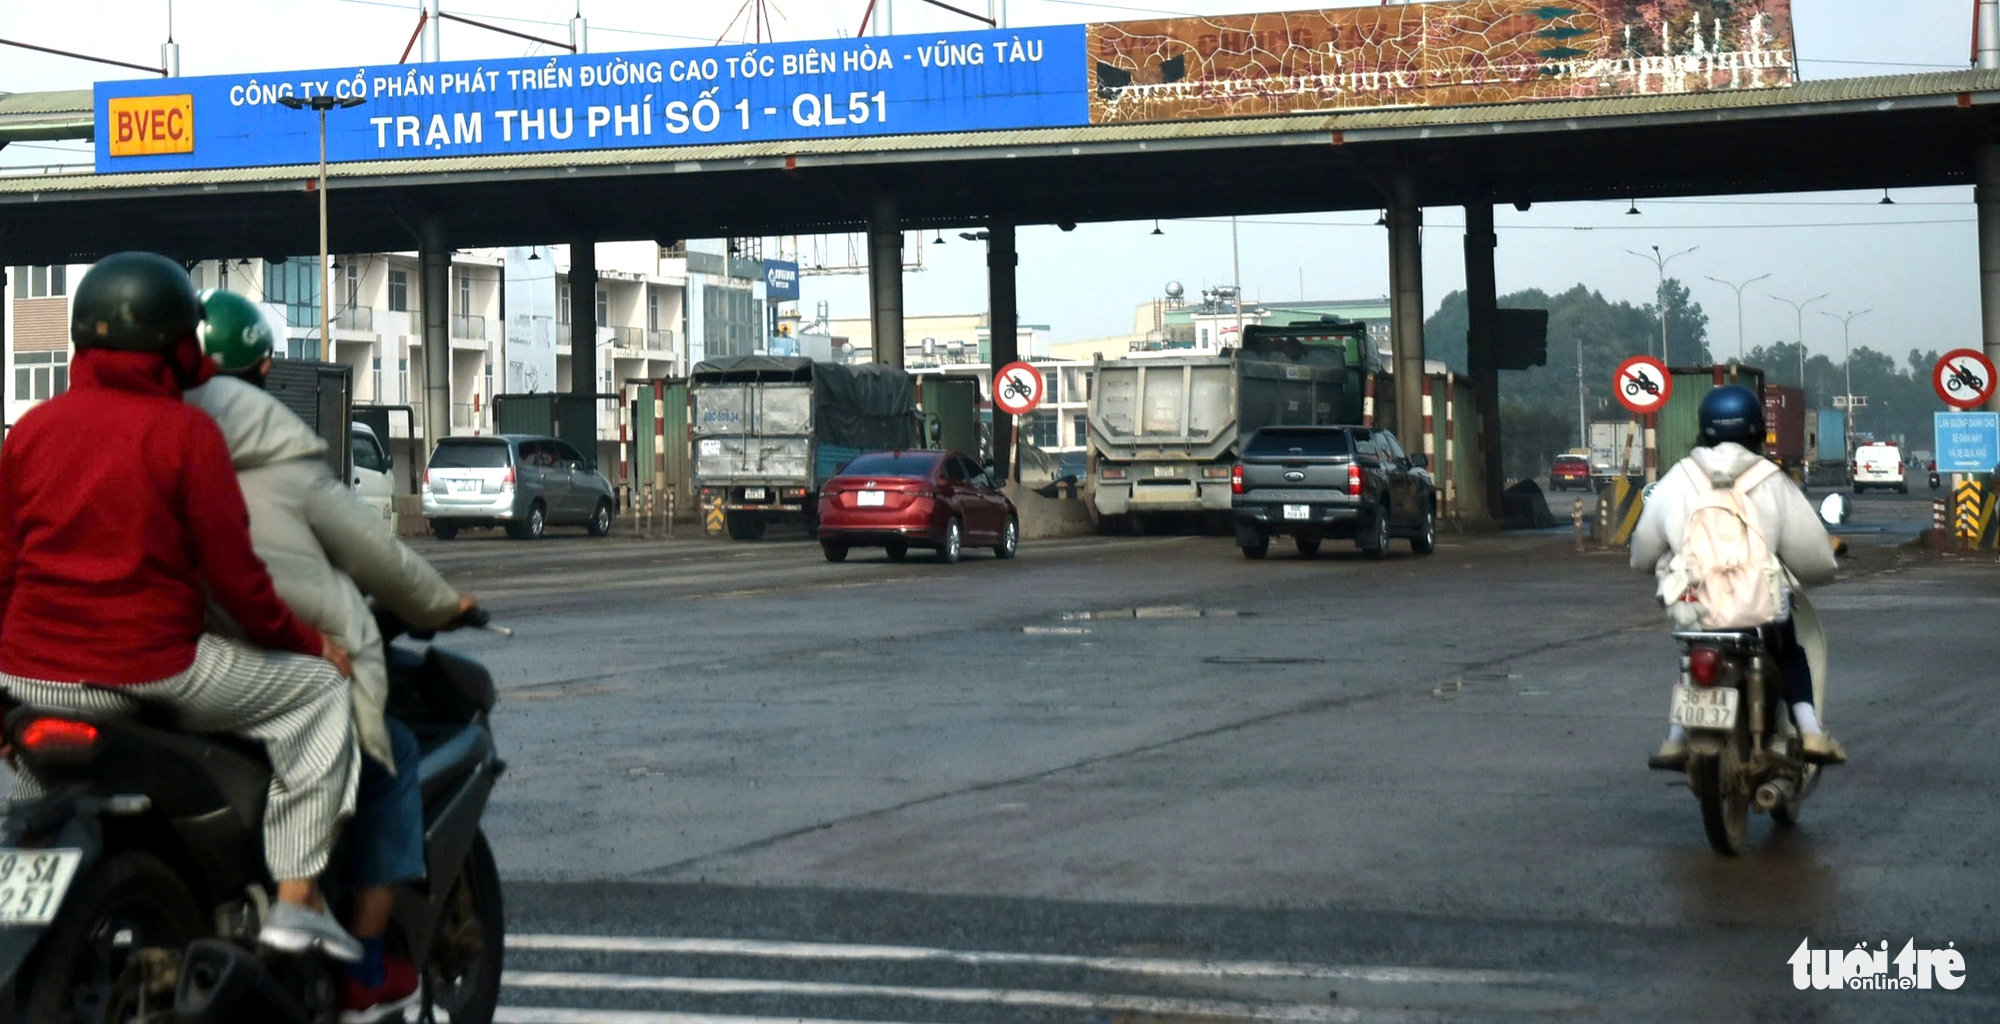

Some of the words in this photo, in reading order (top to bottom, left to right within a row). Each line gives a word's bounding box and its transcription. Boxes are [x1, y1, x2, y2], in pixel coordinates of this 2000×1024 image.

[230, 79, 293, 106] CÔNG
[301, 81, 329, 100] TY
[336, 69, 367, 100] CỔ
[374, 68, 434, 97] PHẦN
[441, 66, 499, 94] PHÁT
[507, 58, 573, 91] TRIỂN
[580, 57, 662, 87] ĐƯỜNG
[669, 59, 718, 82] CAO
[726, 49, 775, 79] TỐC
[783, 48, 836, 75] BIÊN
[843, 44, 893, 72] HÒA
[917, 40, 984, 67] VŨNG
[993, 36, 1043, 63] TÀU
[117, 107, 184, 143] BVEC
[370, 111, 482, 150] TRẠM
[495, 107, 574, 142] THU
[588, 94, 653, 138] PHÍ
[665, 86, 720, 135] SỐ
[735, 98, 750, 130] 1
[791, 90, 886, 128] QL51
